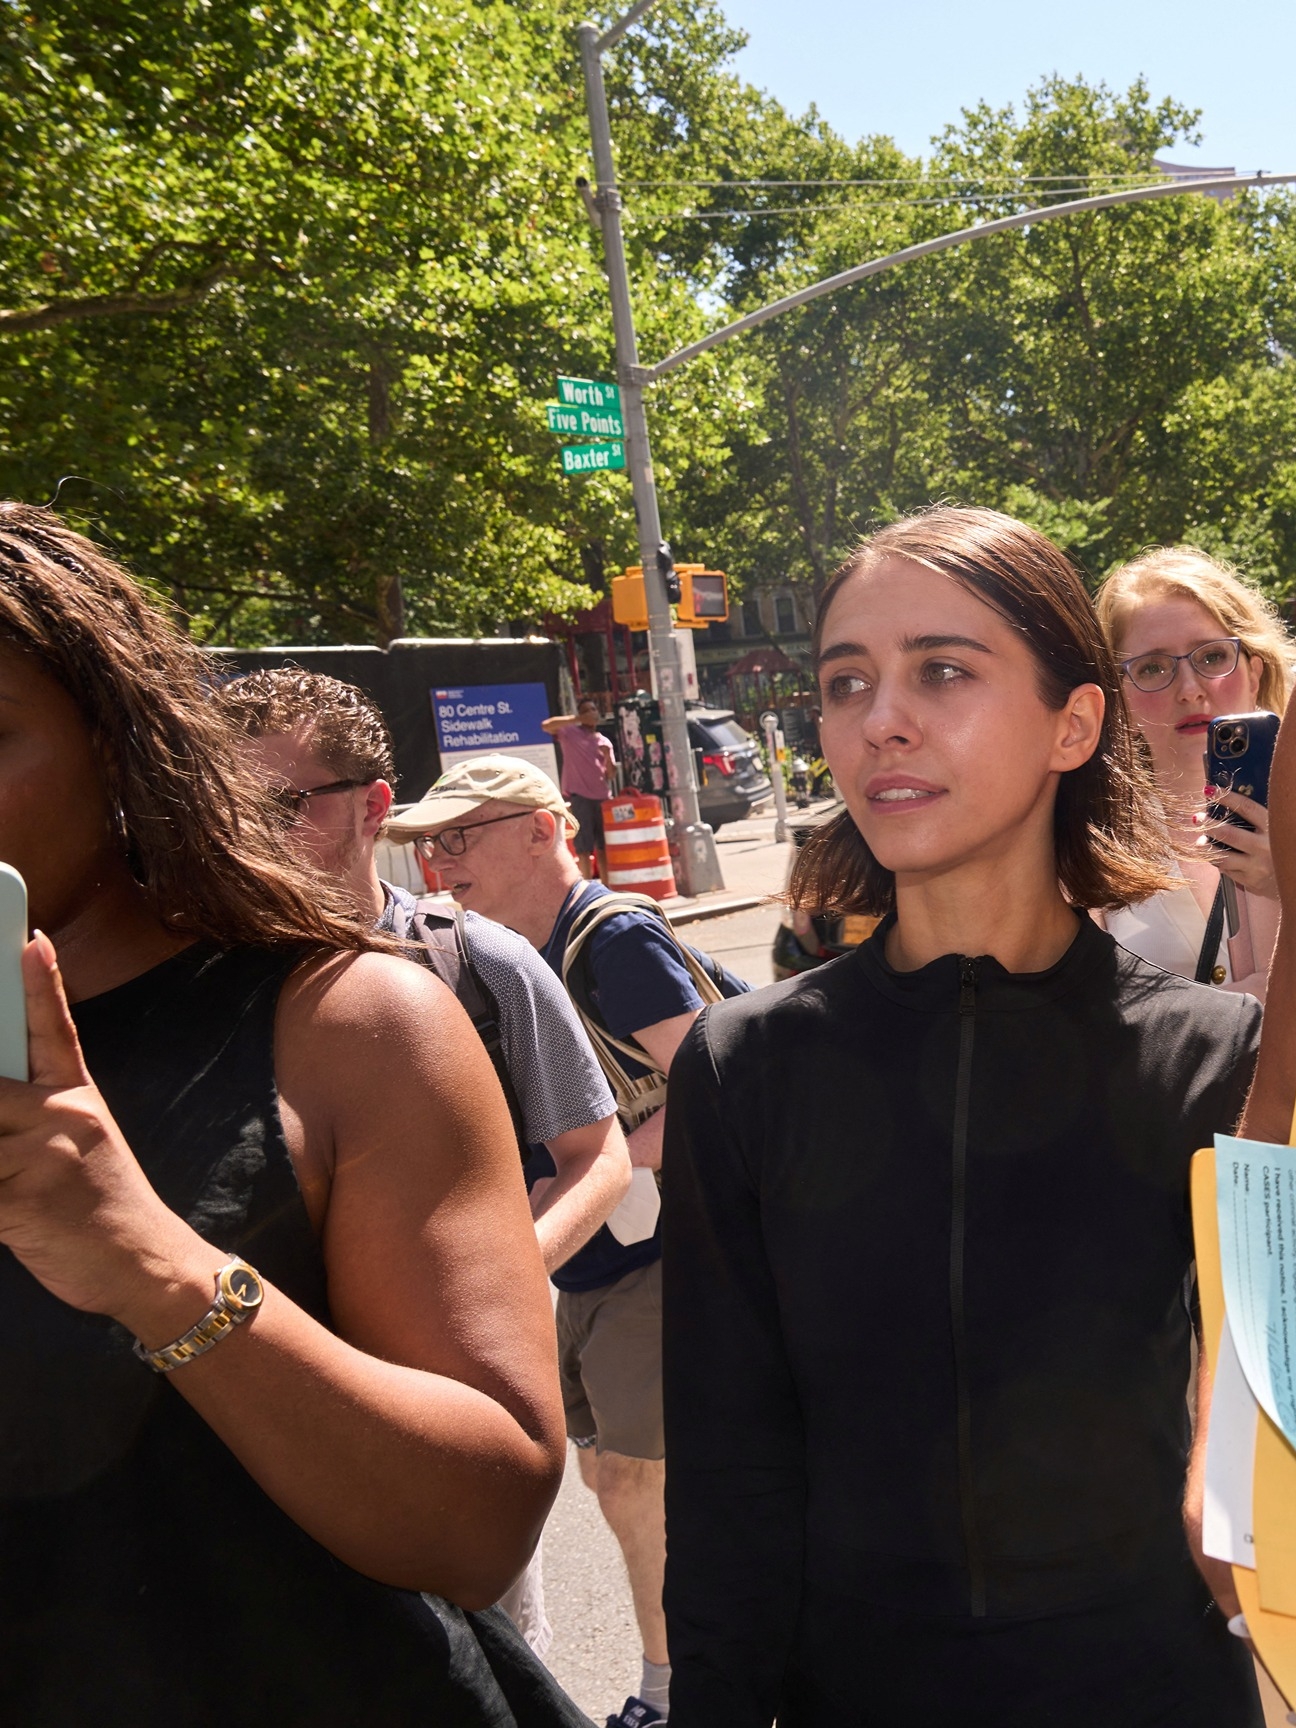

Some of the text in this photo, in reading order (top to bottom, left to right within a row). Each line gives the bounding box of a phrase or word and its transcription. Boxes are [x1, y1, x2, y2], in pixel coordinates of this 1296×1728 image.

[562, 382, 615, 406] Worth St
[548, 408, 621, 435] Five Points
[563, 444, 621, 470] Baxter St
[439, 701, 513, 718] 80 Centre St.
[441, 717, 493, 733] Sidewalk
[443, 731, 519, 747] Rehabilitation
[1263, 1165, 1271, 1199] CASES
[1276, 1198, 1284, 1241] received
